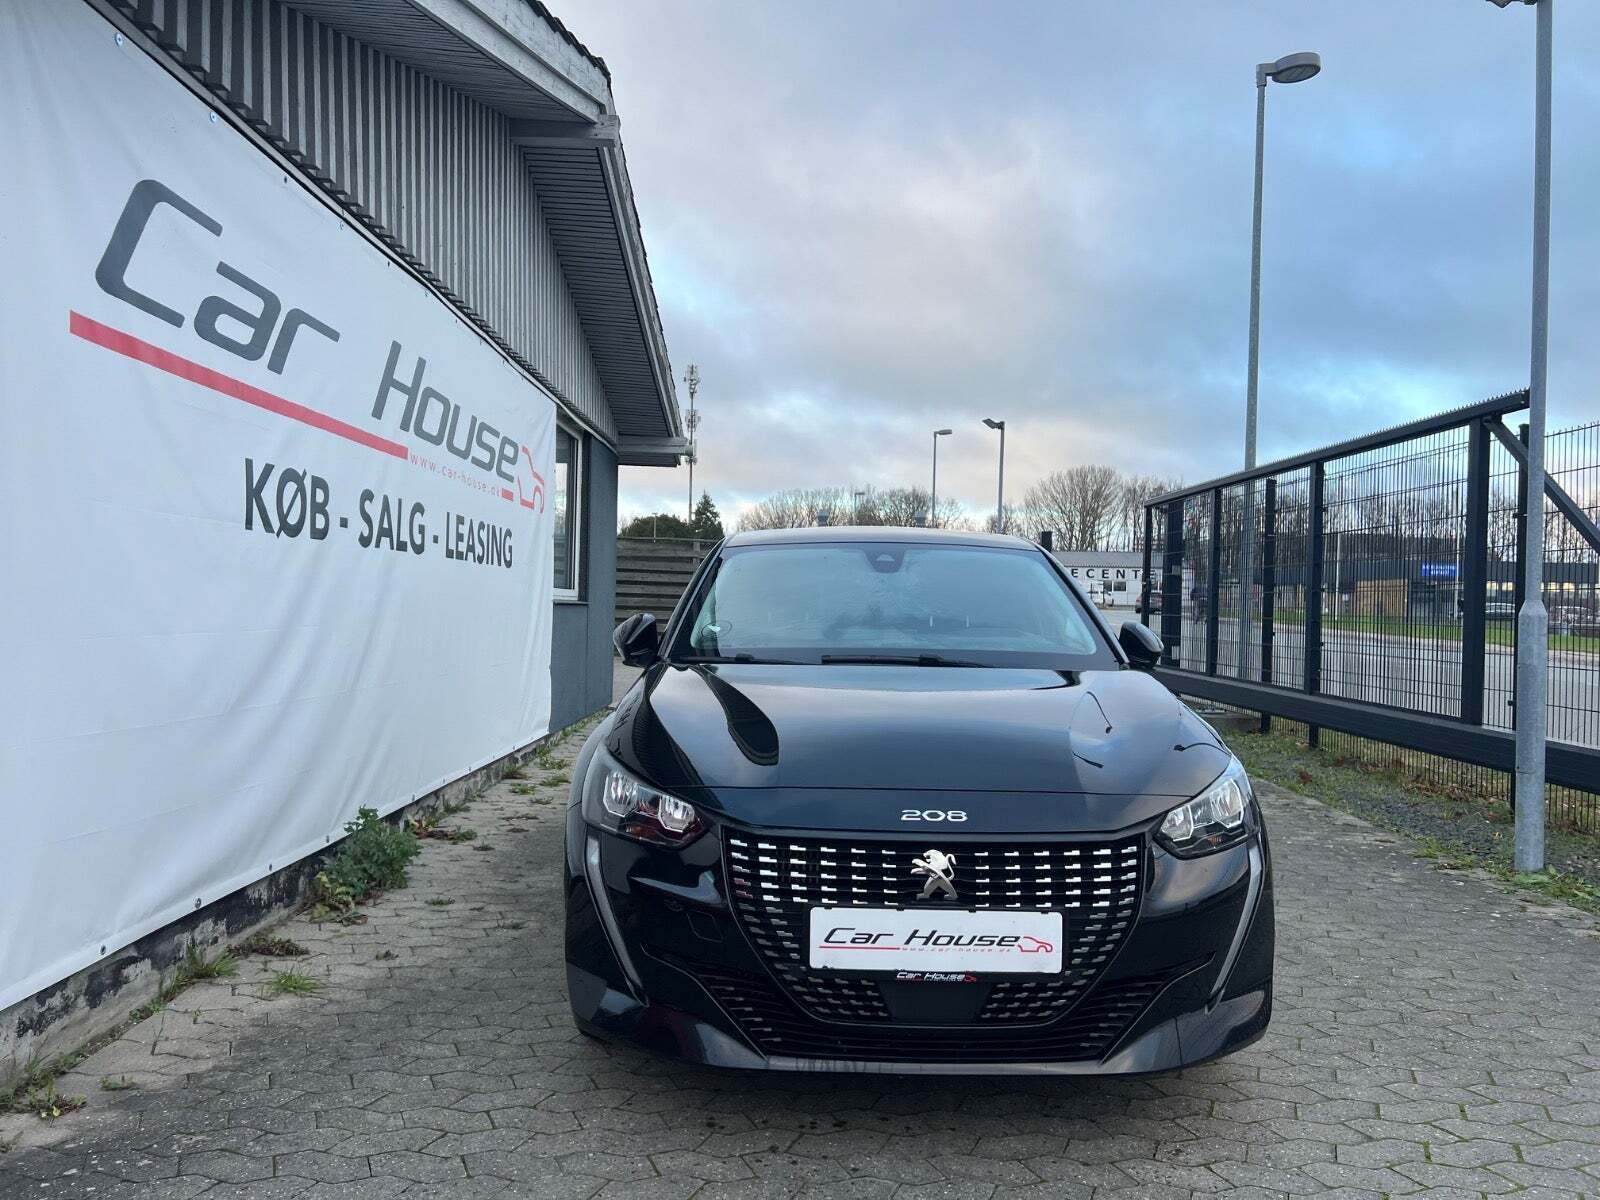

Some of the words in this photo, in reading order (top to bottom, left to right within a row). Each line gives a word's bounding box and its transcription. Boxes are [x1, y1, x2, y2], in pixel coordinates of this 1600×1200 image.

[95, 179, 339, 374] Car
[372, 340, 519, 483] House
[244, 457, 330, 541] KØB
[358, 489, 425, 556] SALG
[445, 511, 513, 569] LEASING
[900, 809, 968, 822] 208
[823, 927, 894, 944] Car
[904, 929, 1021, 946] House
[896, 971, 922, 979] Car
[923, 972, 966, 982] House
